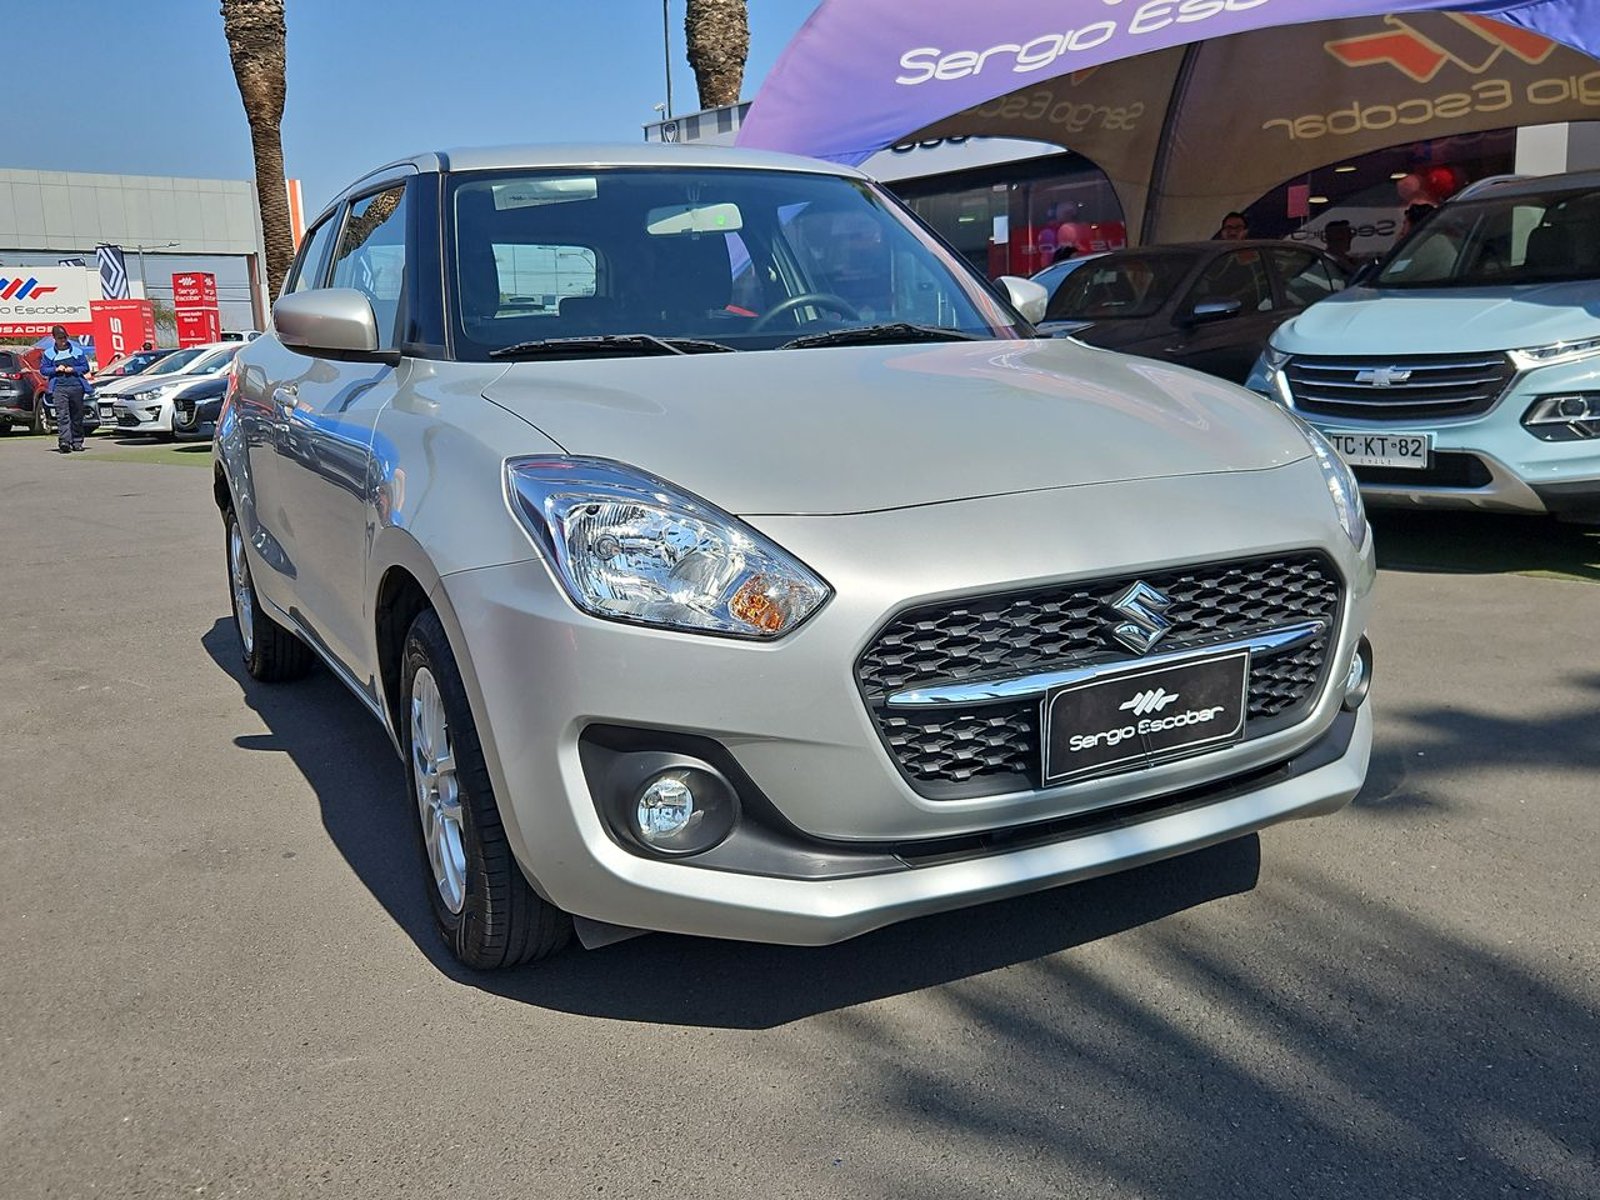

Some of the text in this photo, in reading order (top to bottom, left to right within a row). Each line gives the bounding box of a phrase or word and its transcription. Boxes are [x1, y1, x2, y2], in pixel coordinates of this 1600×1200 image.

[895, 19, 1118, 85] Sergio
[15, 305, 86, 315] Escobar
[1069, 705, 1225, 751] Sergio Escobar
